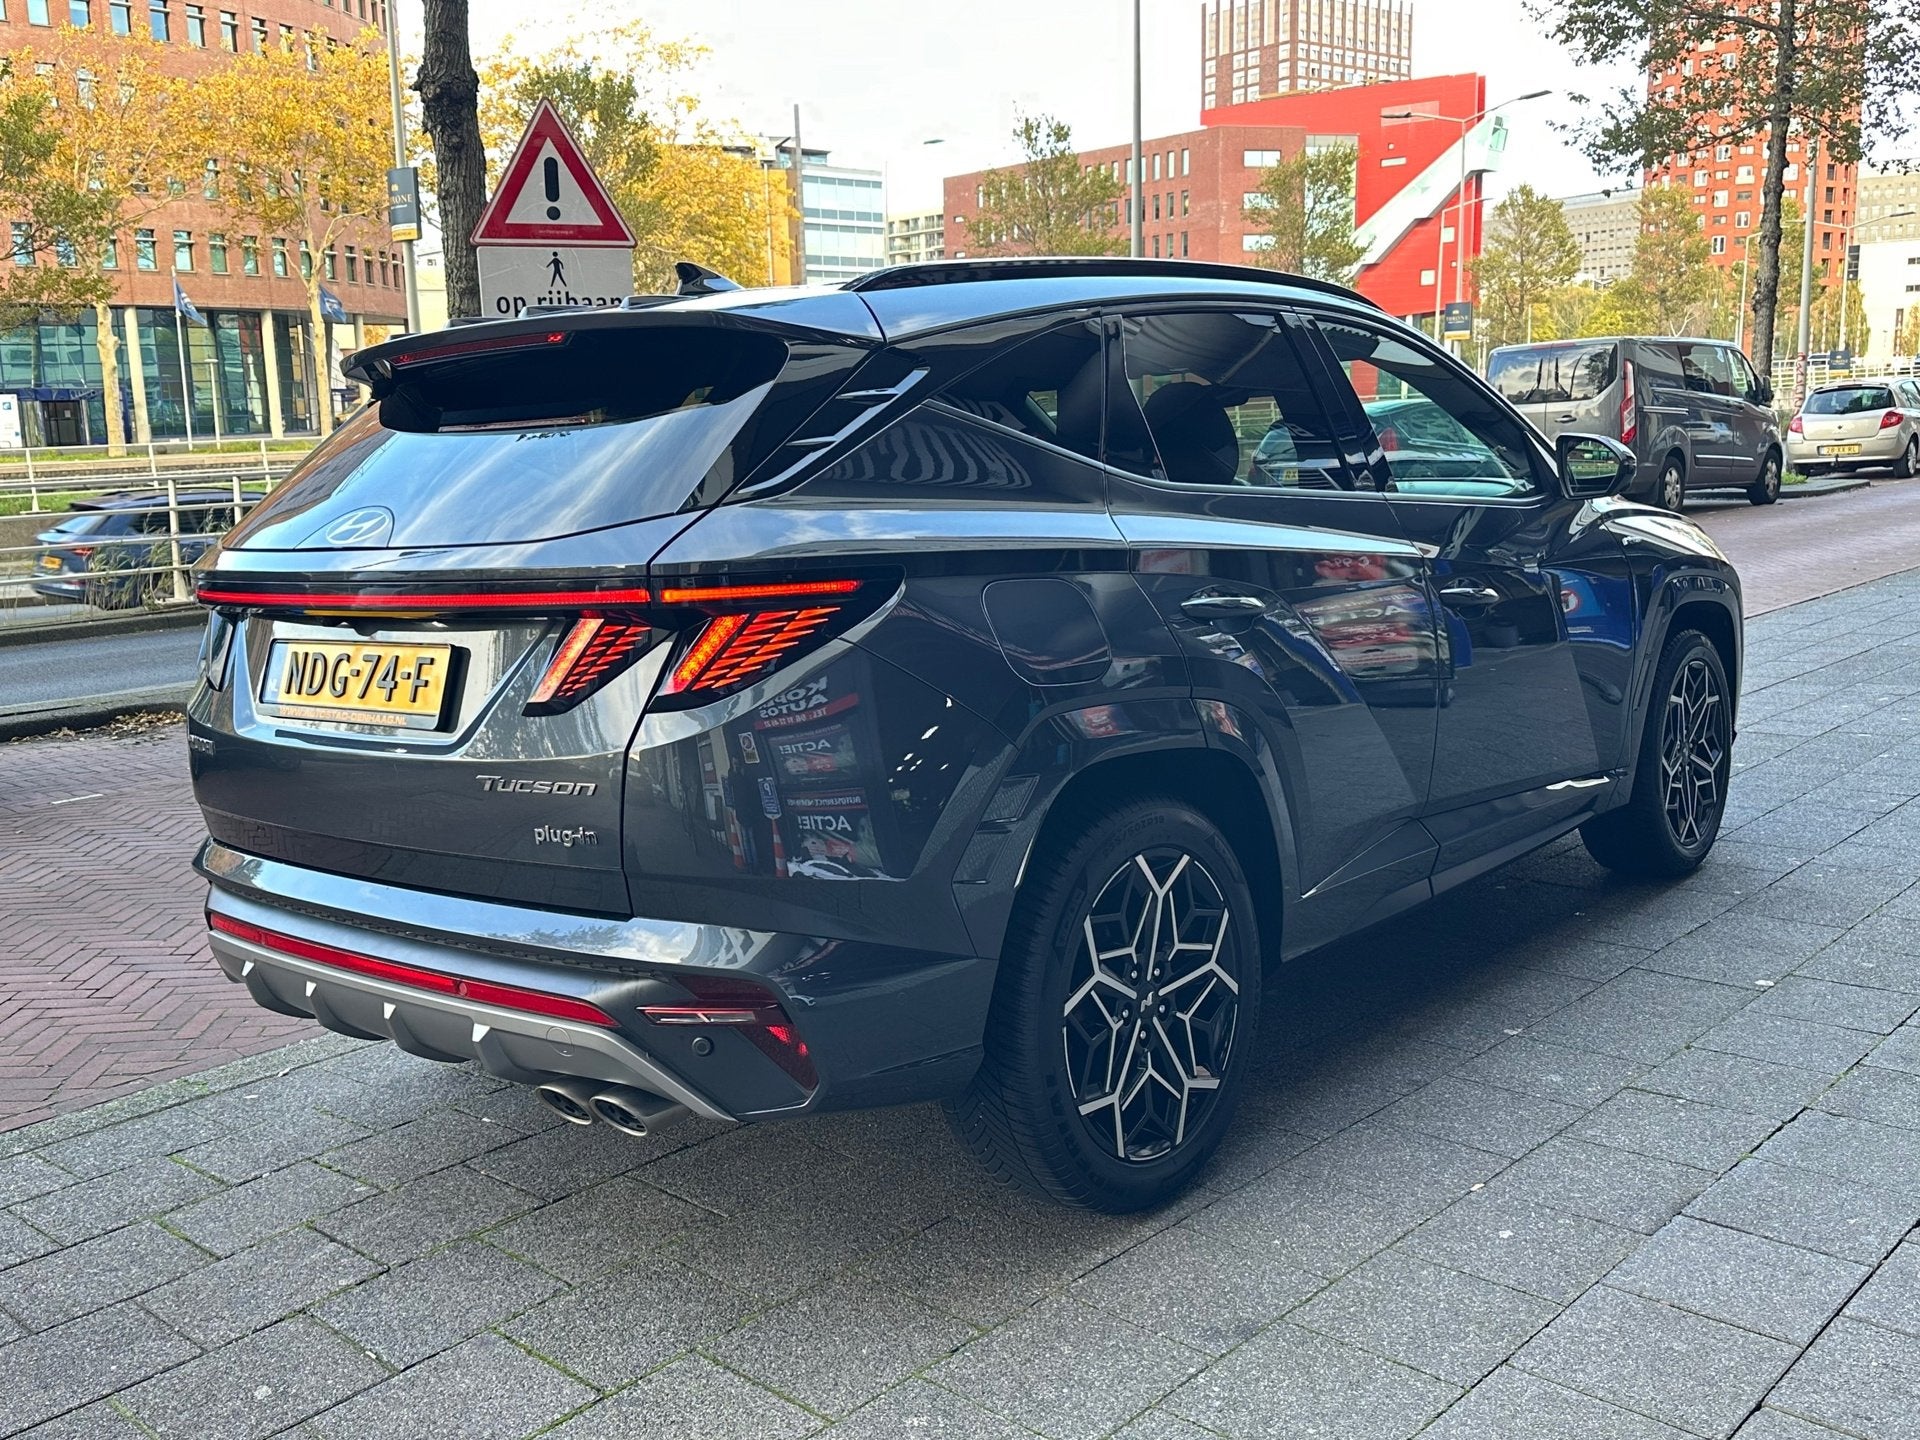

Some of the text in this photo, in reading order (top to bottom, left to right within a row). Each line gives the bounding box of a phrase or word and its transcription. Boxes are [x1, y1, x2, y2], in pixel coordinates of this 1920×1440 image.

[496, 296, 527, 317] op
[284, 651, 436, 703] NDG-74-F
[534, 825, 597, 847] plug-in
